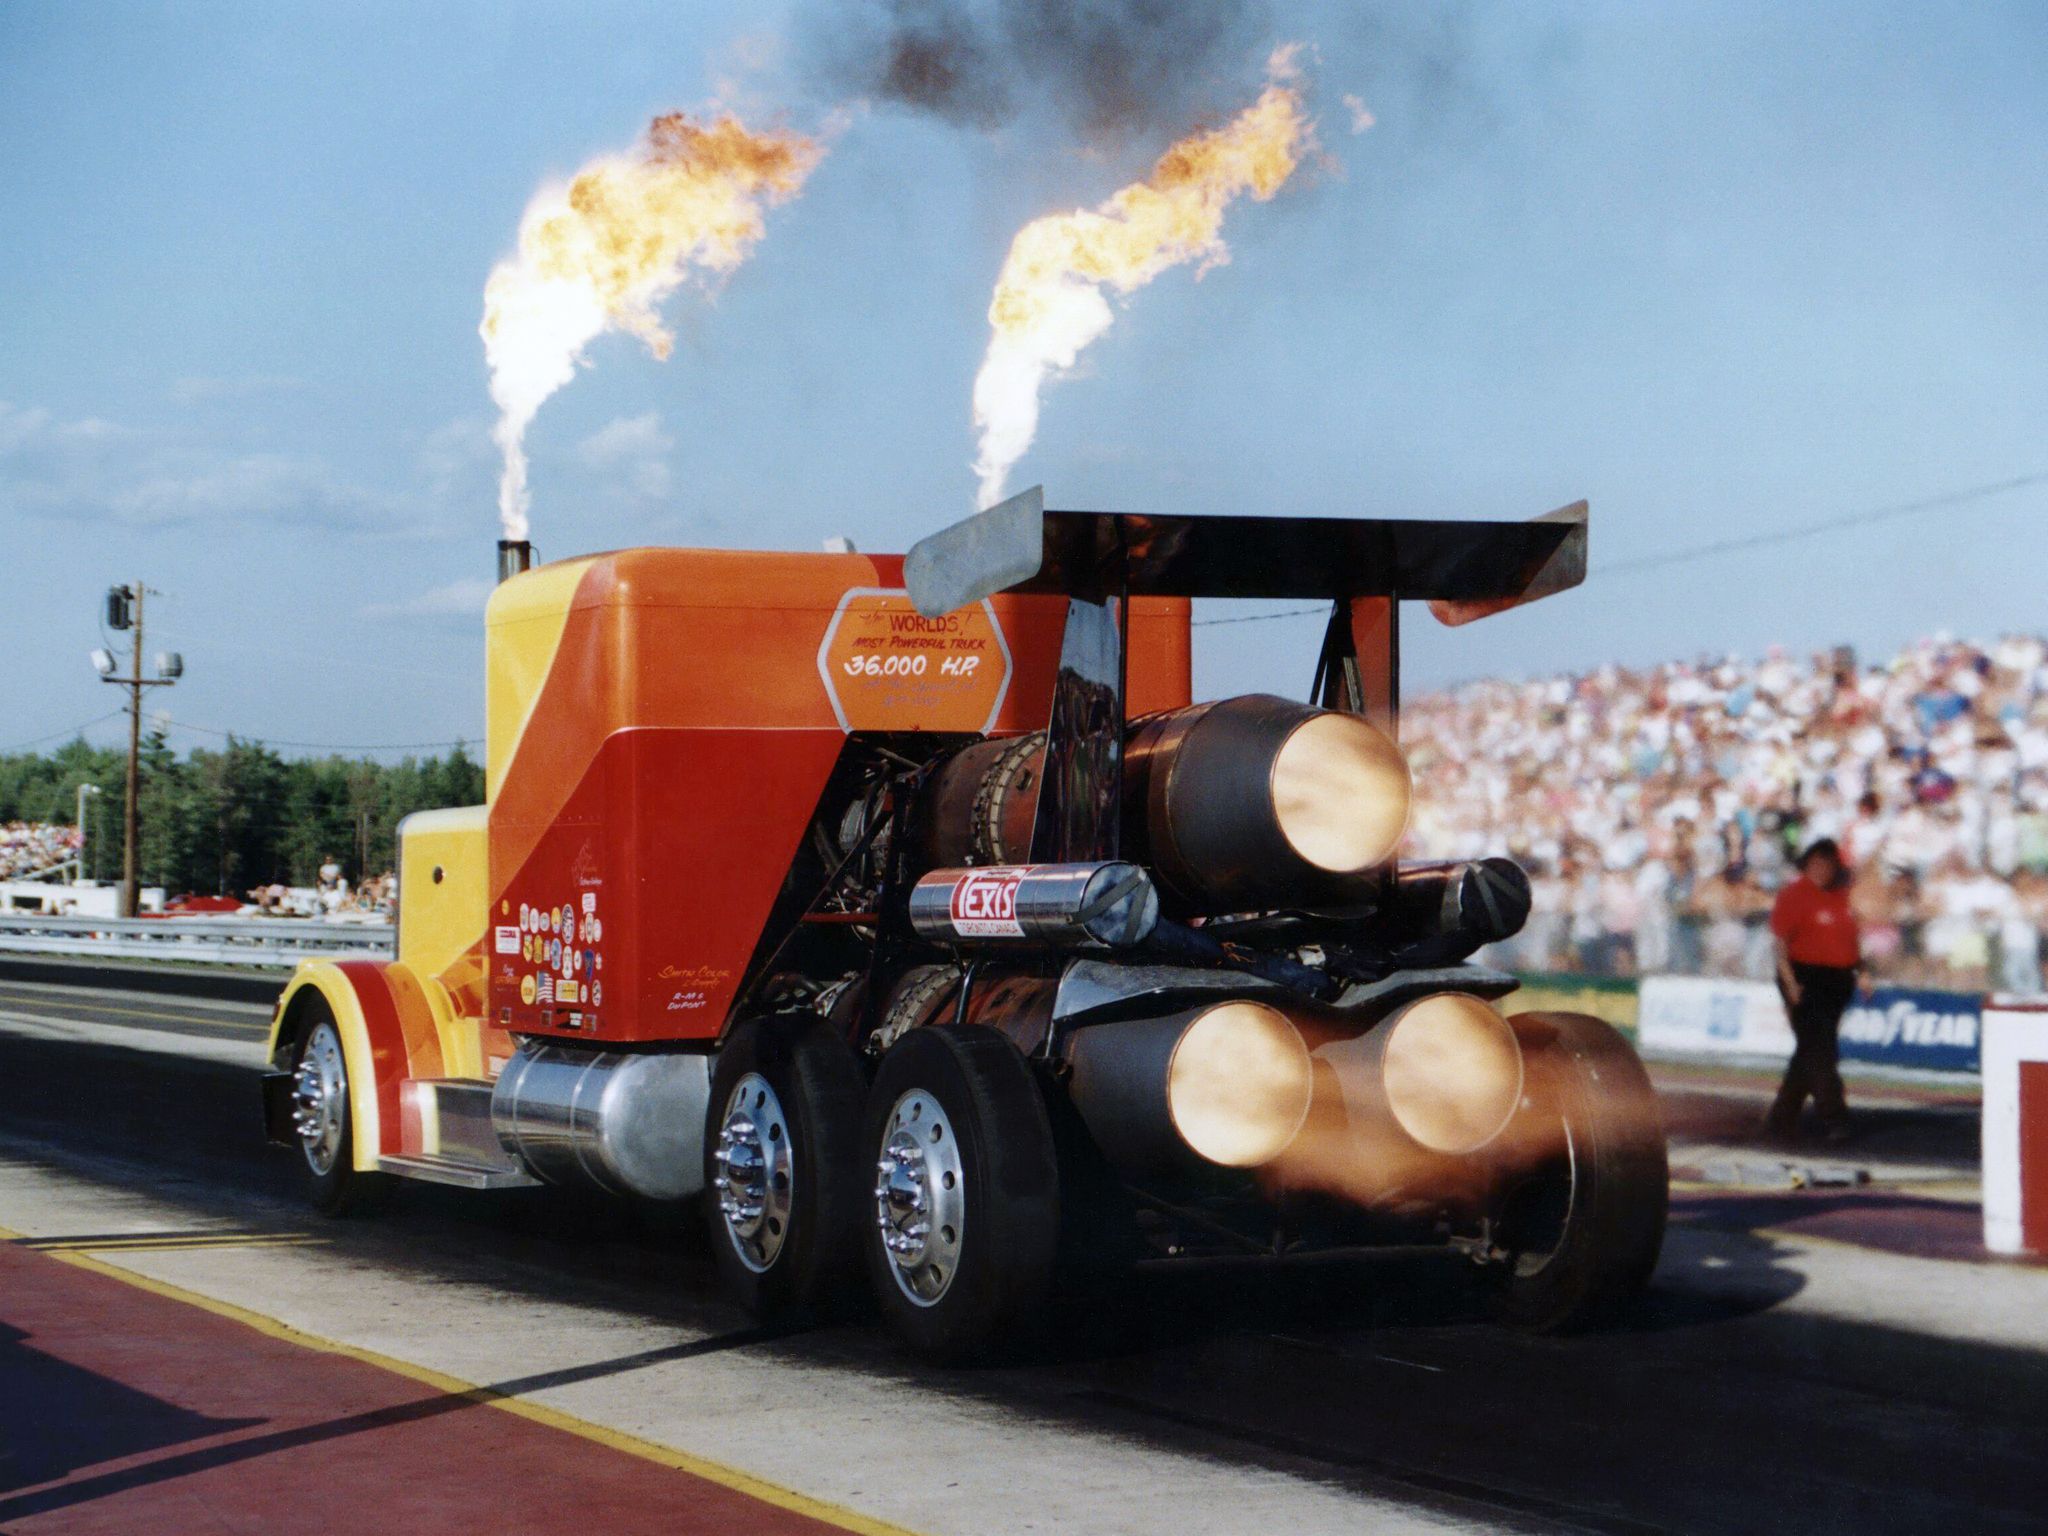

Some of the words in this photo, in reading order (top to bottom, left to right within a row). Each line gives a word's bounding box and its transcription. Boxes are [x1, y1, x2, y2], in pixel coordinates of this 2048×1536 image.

[852, 637, 885, 649] MOST
[889, 636, 945, 649] POWERFUL
[950, 639, 986, 650] TRUCK
[941, 656, 980, 676] H.P.
